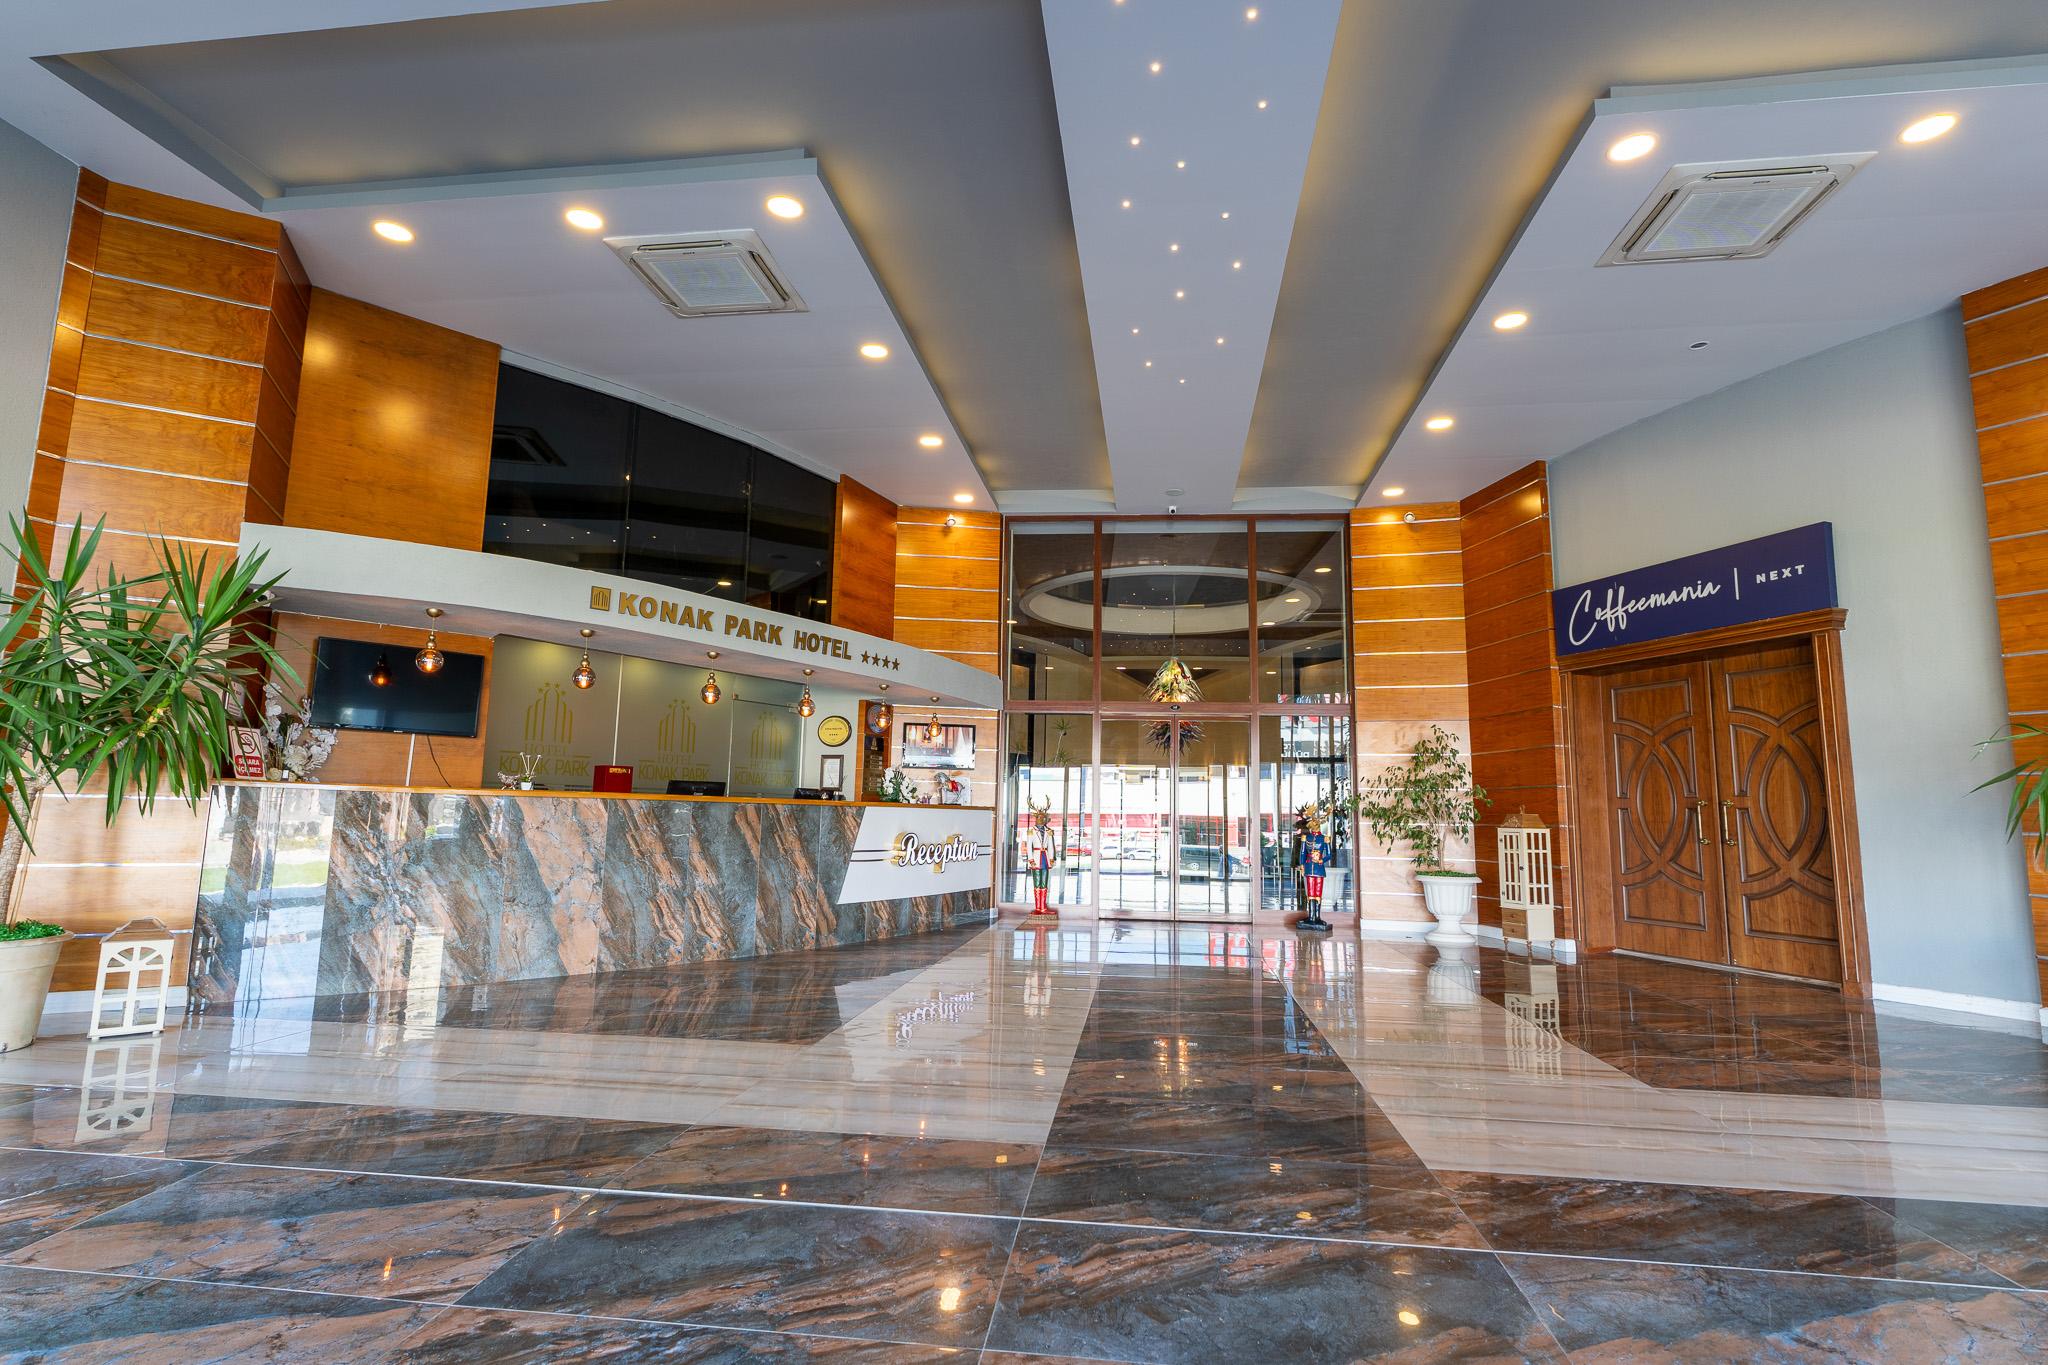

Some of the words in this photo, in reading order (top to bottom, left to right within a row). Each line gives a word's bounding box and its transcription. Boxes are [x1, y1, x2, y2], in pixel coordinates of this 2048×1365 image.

[1568, 580, 1721, 646] Coffeemania
[1755, 564, 1806, 585] NEXT
[618, 590, 714, 633] KONAK
[723, 613, 785, 647] PARK
[792, 629, 853, 661] HOTEL
[238, 757, 260, 766] SARA
[555, 758, 591, 777] PARK
[638, 764, 677, 780] KONAK
[681, 767, 712, 780] PARK
[734, 768, 768, 785] KONAK
[896, 832, 979, 873] Reception
